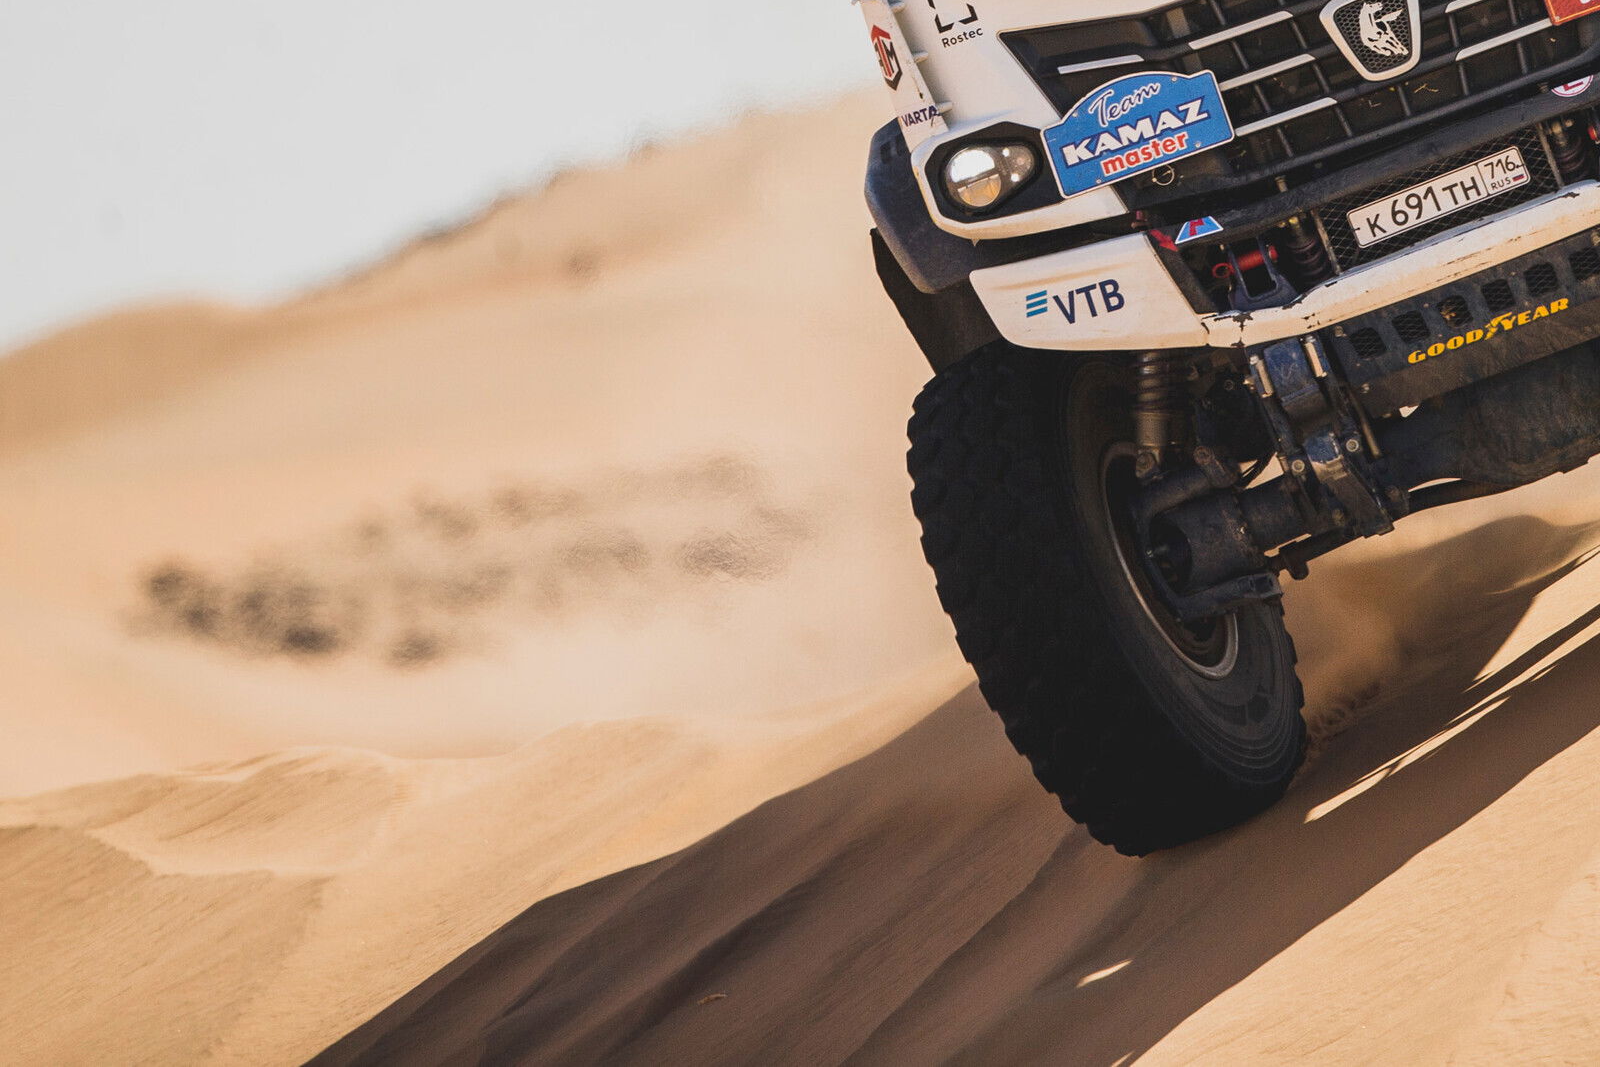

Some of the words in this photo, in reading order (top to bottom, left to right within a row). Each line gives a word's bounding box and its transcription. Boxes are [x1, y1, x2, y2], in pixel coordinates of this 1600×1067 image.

[941, 26, 984, 49] Rostec
[901, 105, 939, 128] VARTA
[1088, 81, 1161, 128] Team
[1060, 95, 1212, 167] KAMAZ
[1102, 131, 1188, 178] master
[1483, 154, 1517, 180] 716
[1490, 176, 1512, 191] RUS
[1390, 186, 1442, 227] 691
[1053, 278, 1126, 325] VTB
[1407, 297, 1569, 365] GOODYEAR
